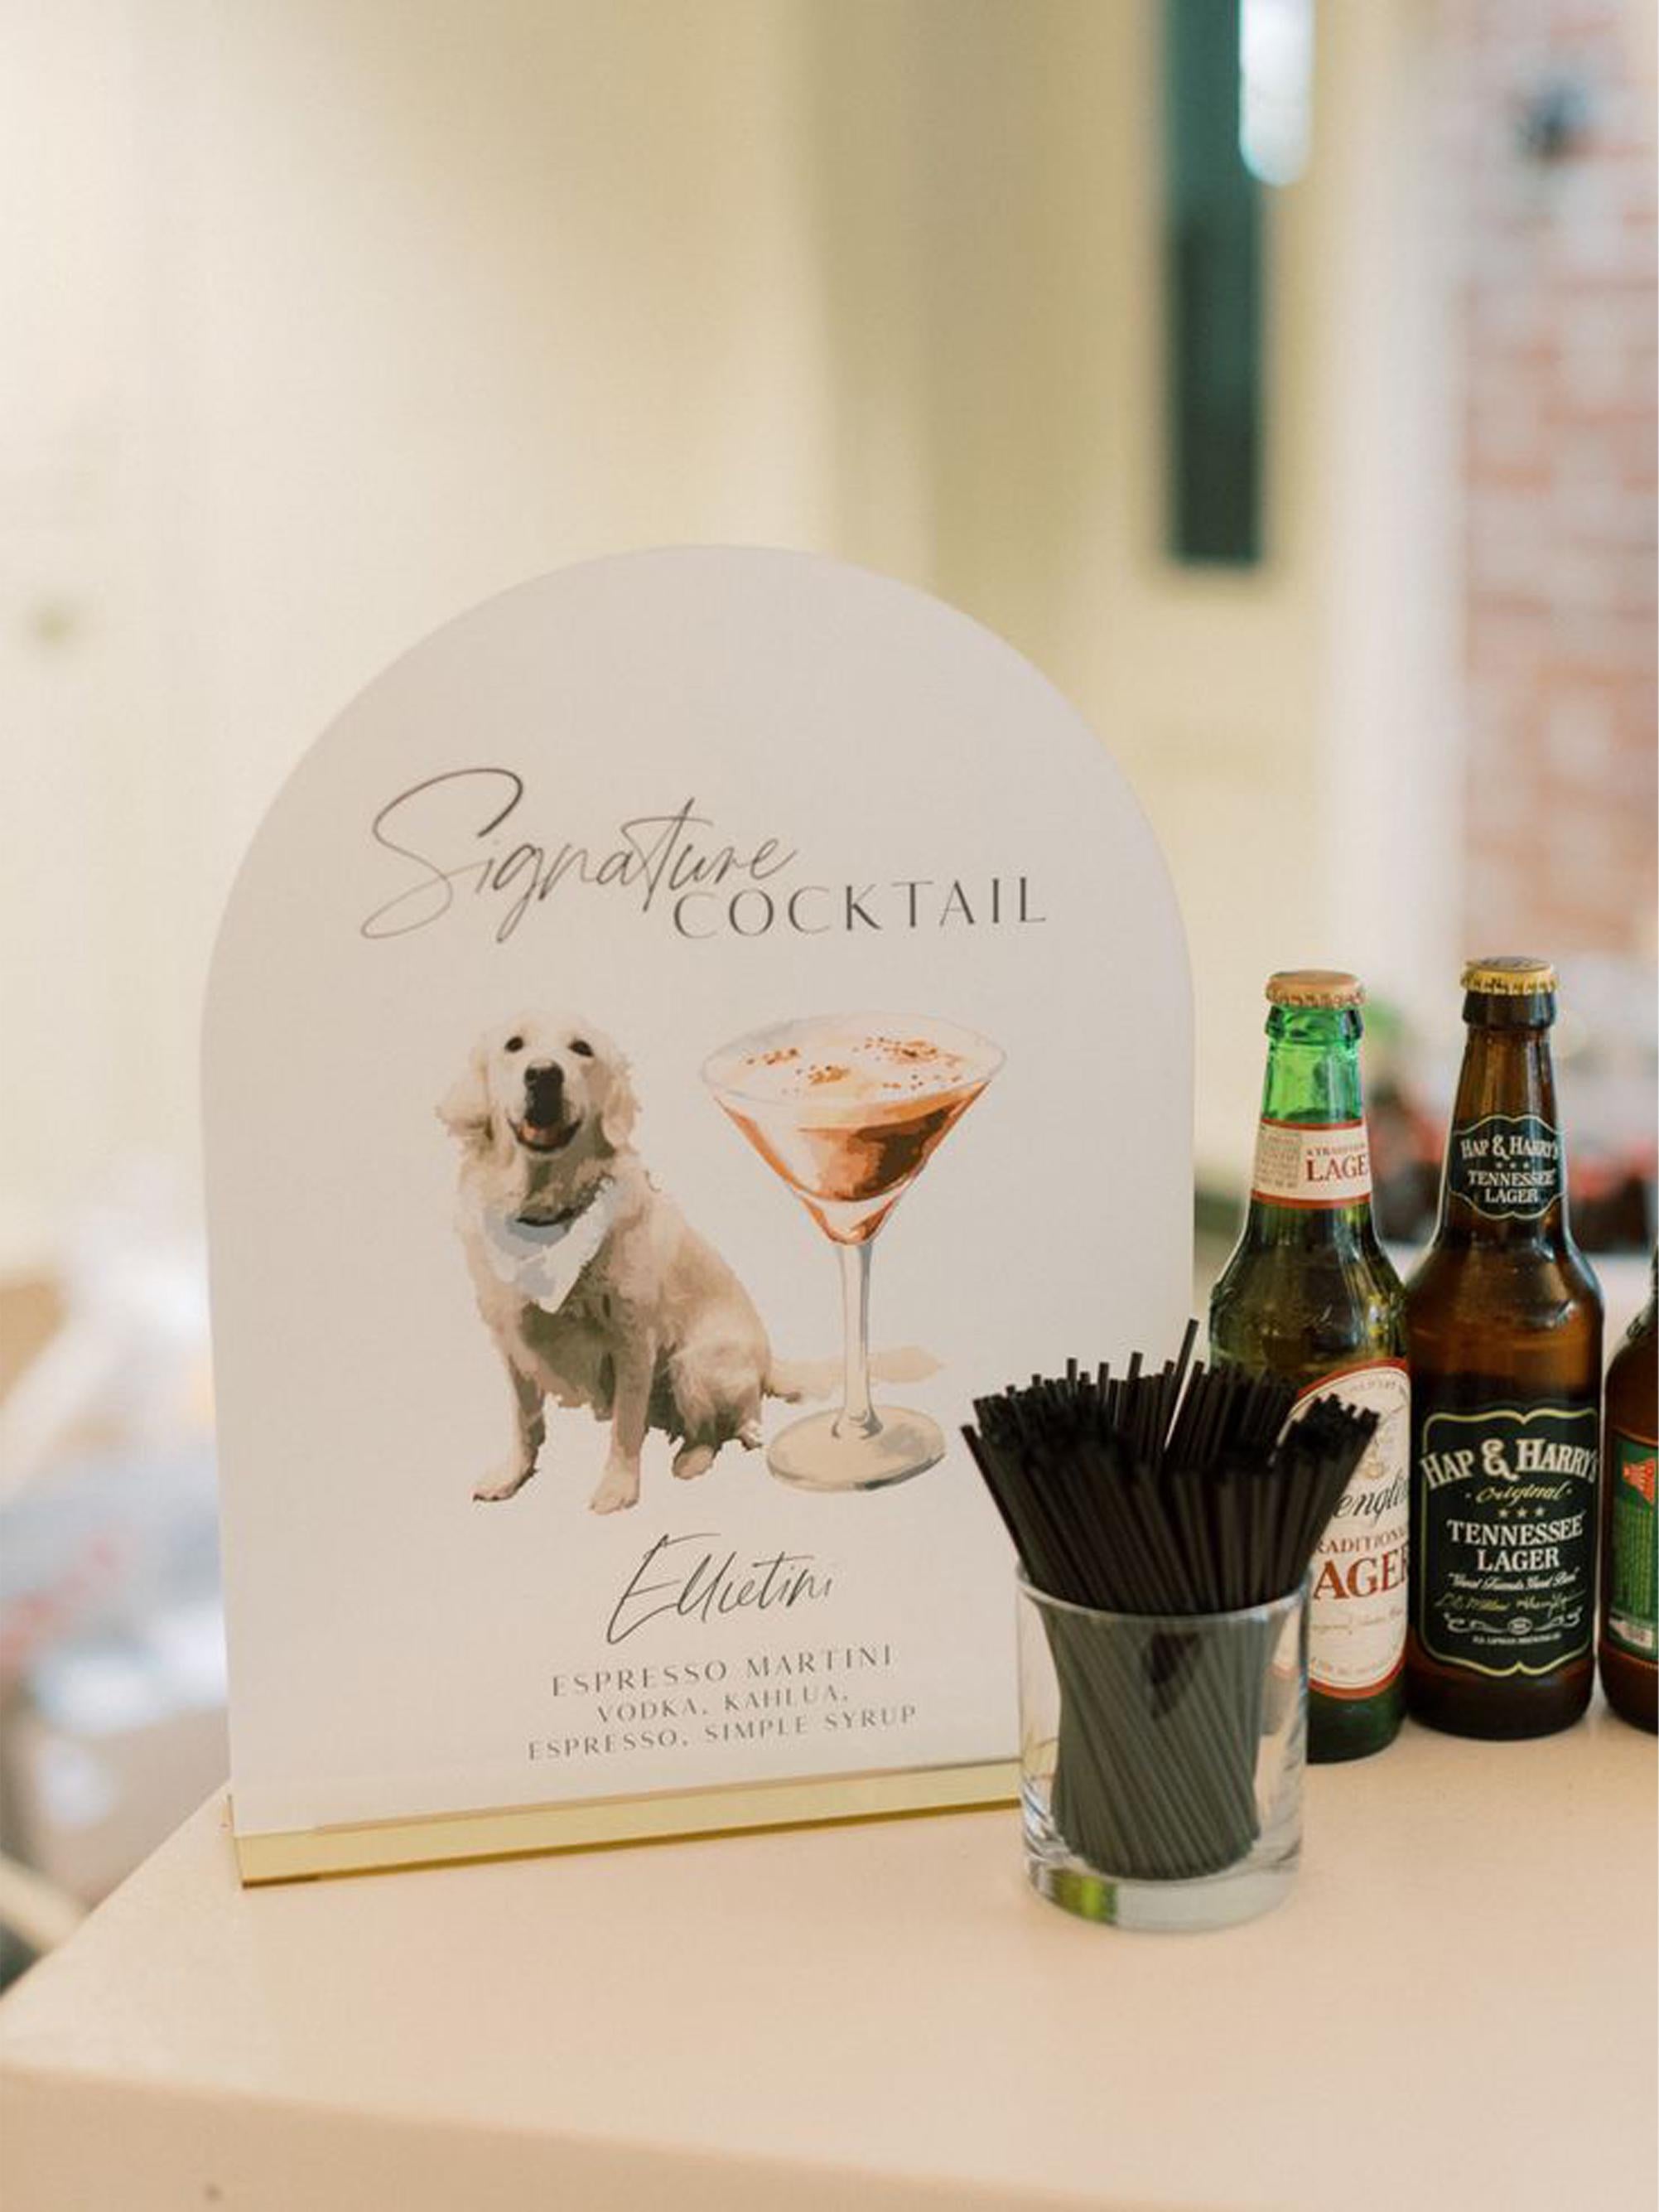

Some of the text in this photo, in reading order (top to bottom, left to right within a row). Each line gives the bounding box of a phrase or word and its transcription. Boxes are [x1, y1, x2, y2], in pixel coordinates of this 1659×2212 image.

[361, 768, 798, 943] Signature
[673, 875, 1047, 940] COCKTAIL
[1460, 1138, 1490, 1159] HAP
[1492, 1134, 1511, 1161] &
[1306, 1154, 1368, 1181] LAGE
[1467, 1168, 1556, 1186] TENNESSEE
[1484, 1188, 1539, 1204] LAGER
[1420, 1450, 1474, 1490] HAP
[1481, 1438, 1520, 1481] &
[1475, 1480, 1572, 1507] Original
[1446, 1509, 1587, 1546] TENNESSEE
[1477, 1546, 1560, 1572] LAGER
[605, 1533, 832, 1645] Ellietini
[552, 1645, 893, 1698] ESPRESSO MARTINI
[704, 1715, 808, 1743] SIMPLE
[825, 1705, 917, 1730] SYRUP
